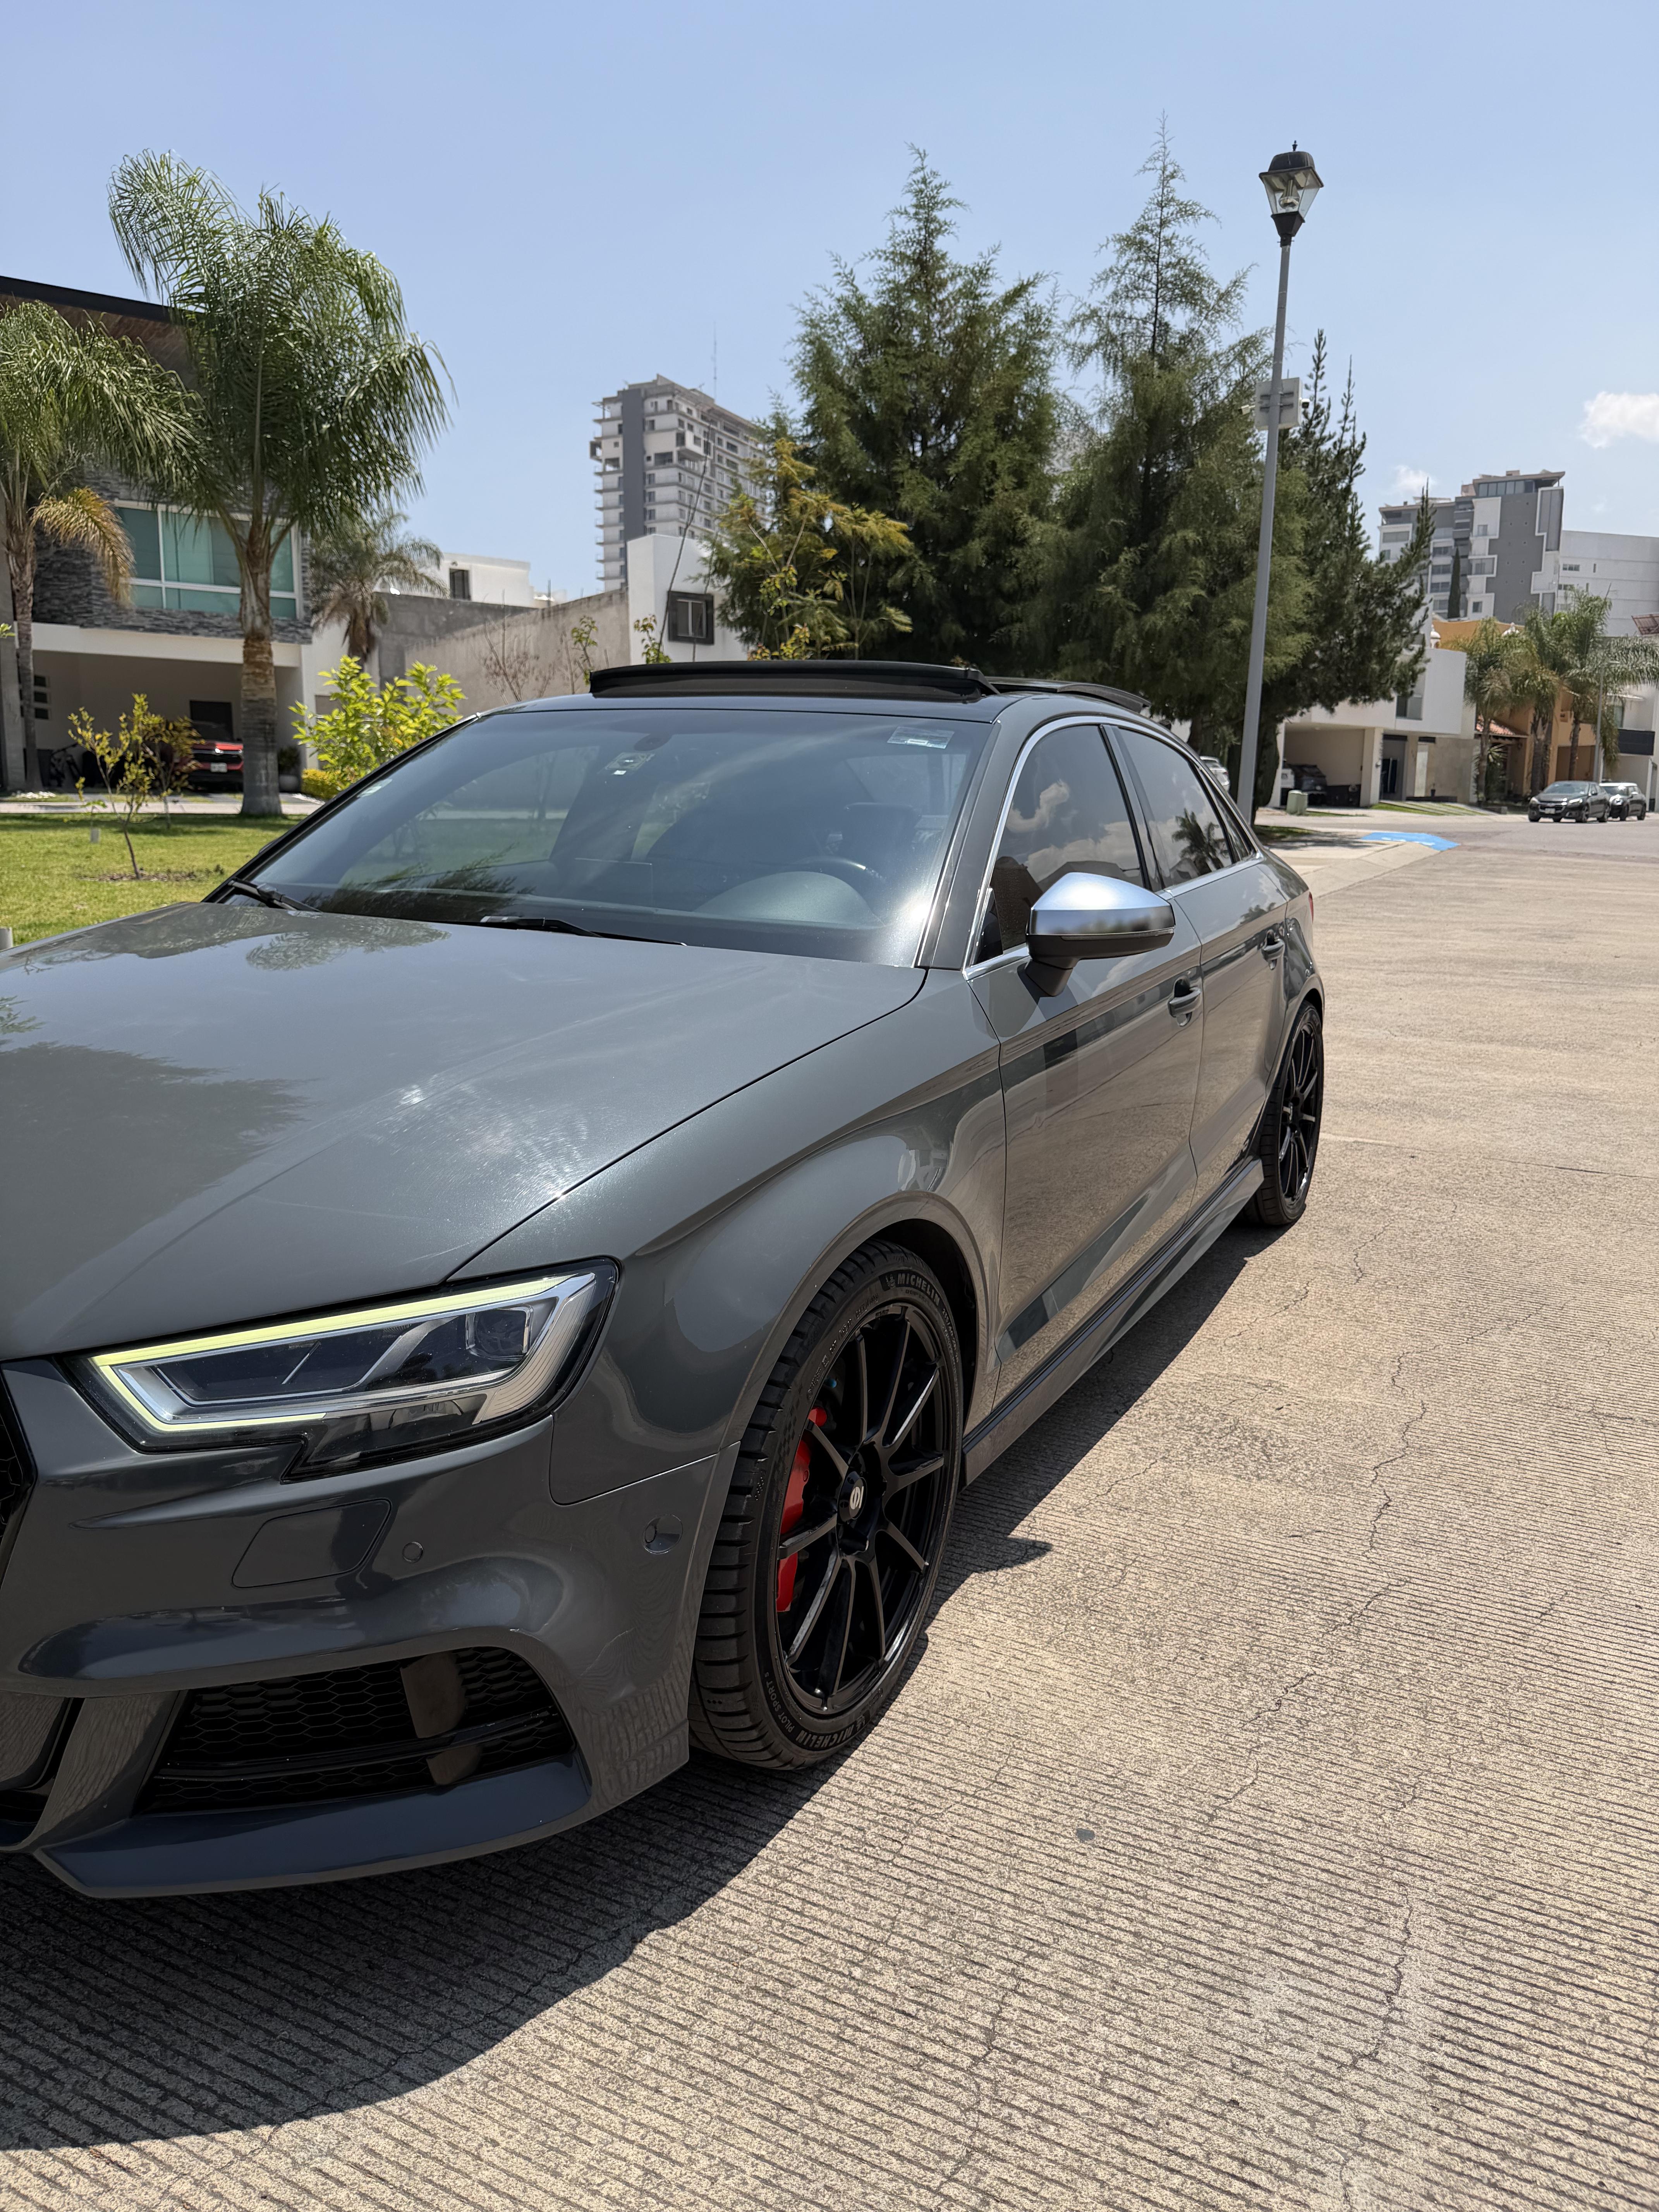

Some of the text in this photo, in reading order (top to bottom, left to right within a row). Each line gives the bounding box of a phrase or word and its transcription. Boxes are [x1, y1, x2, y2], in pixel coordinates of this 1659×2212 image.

[897, 1273, 941, 1307] MICHELIN
[766, 1680, 781, 1712] SPORT
[778, 1712, 795, 1733] PILOT
[795, 1724, 854, 1748] MICHELIN
